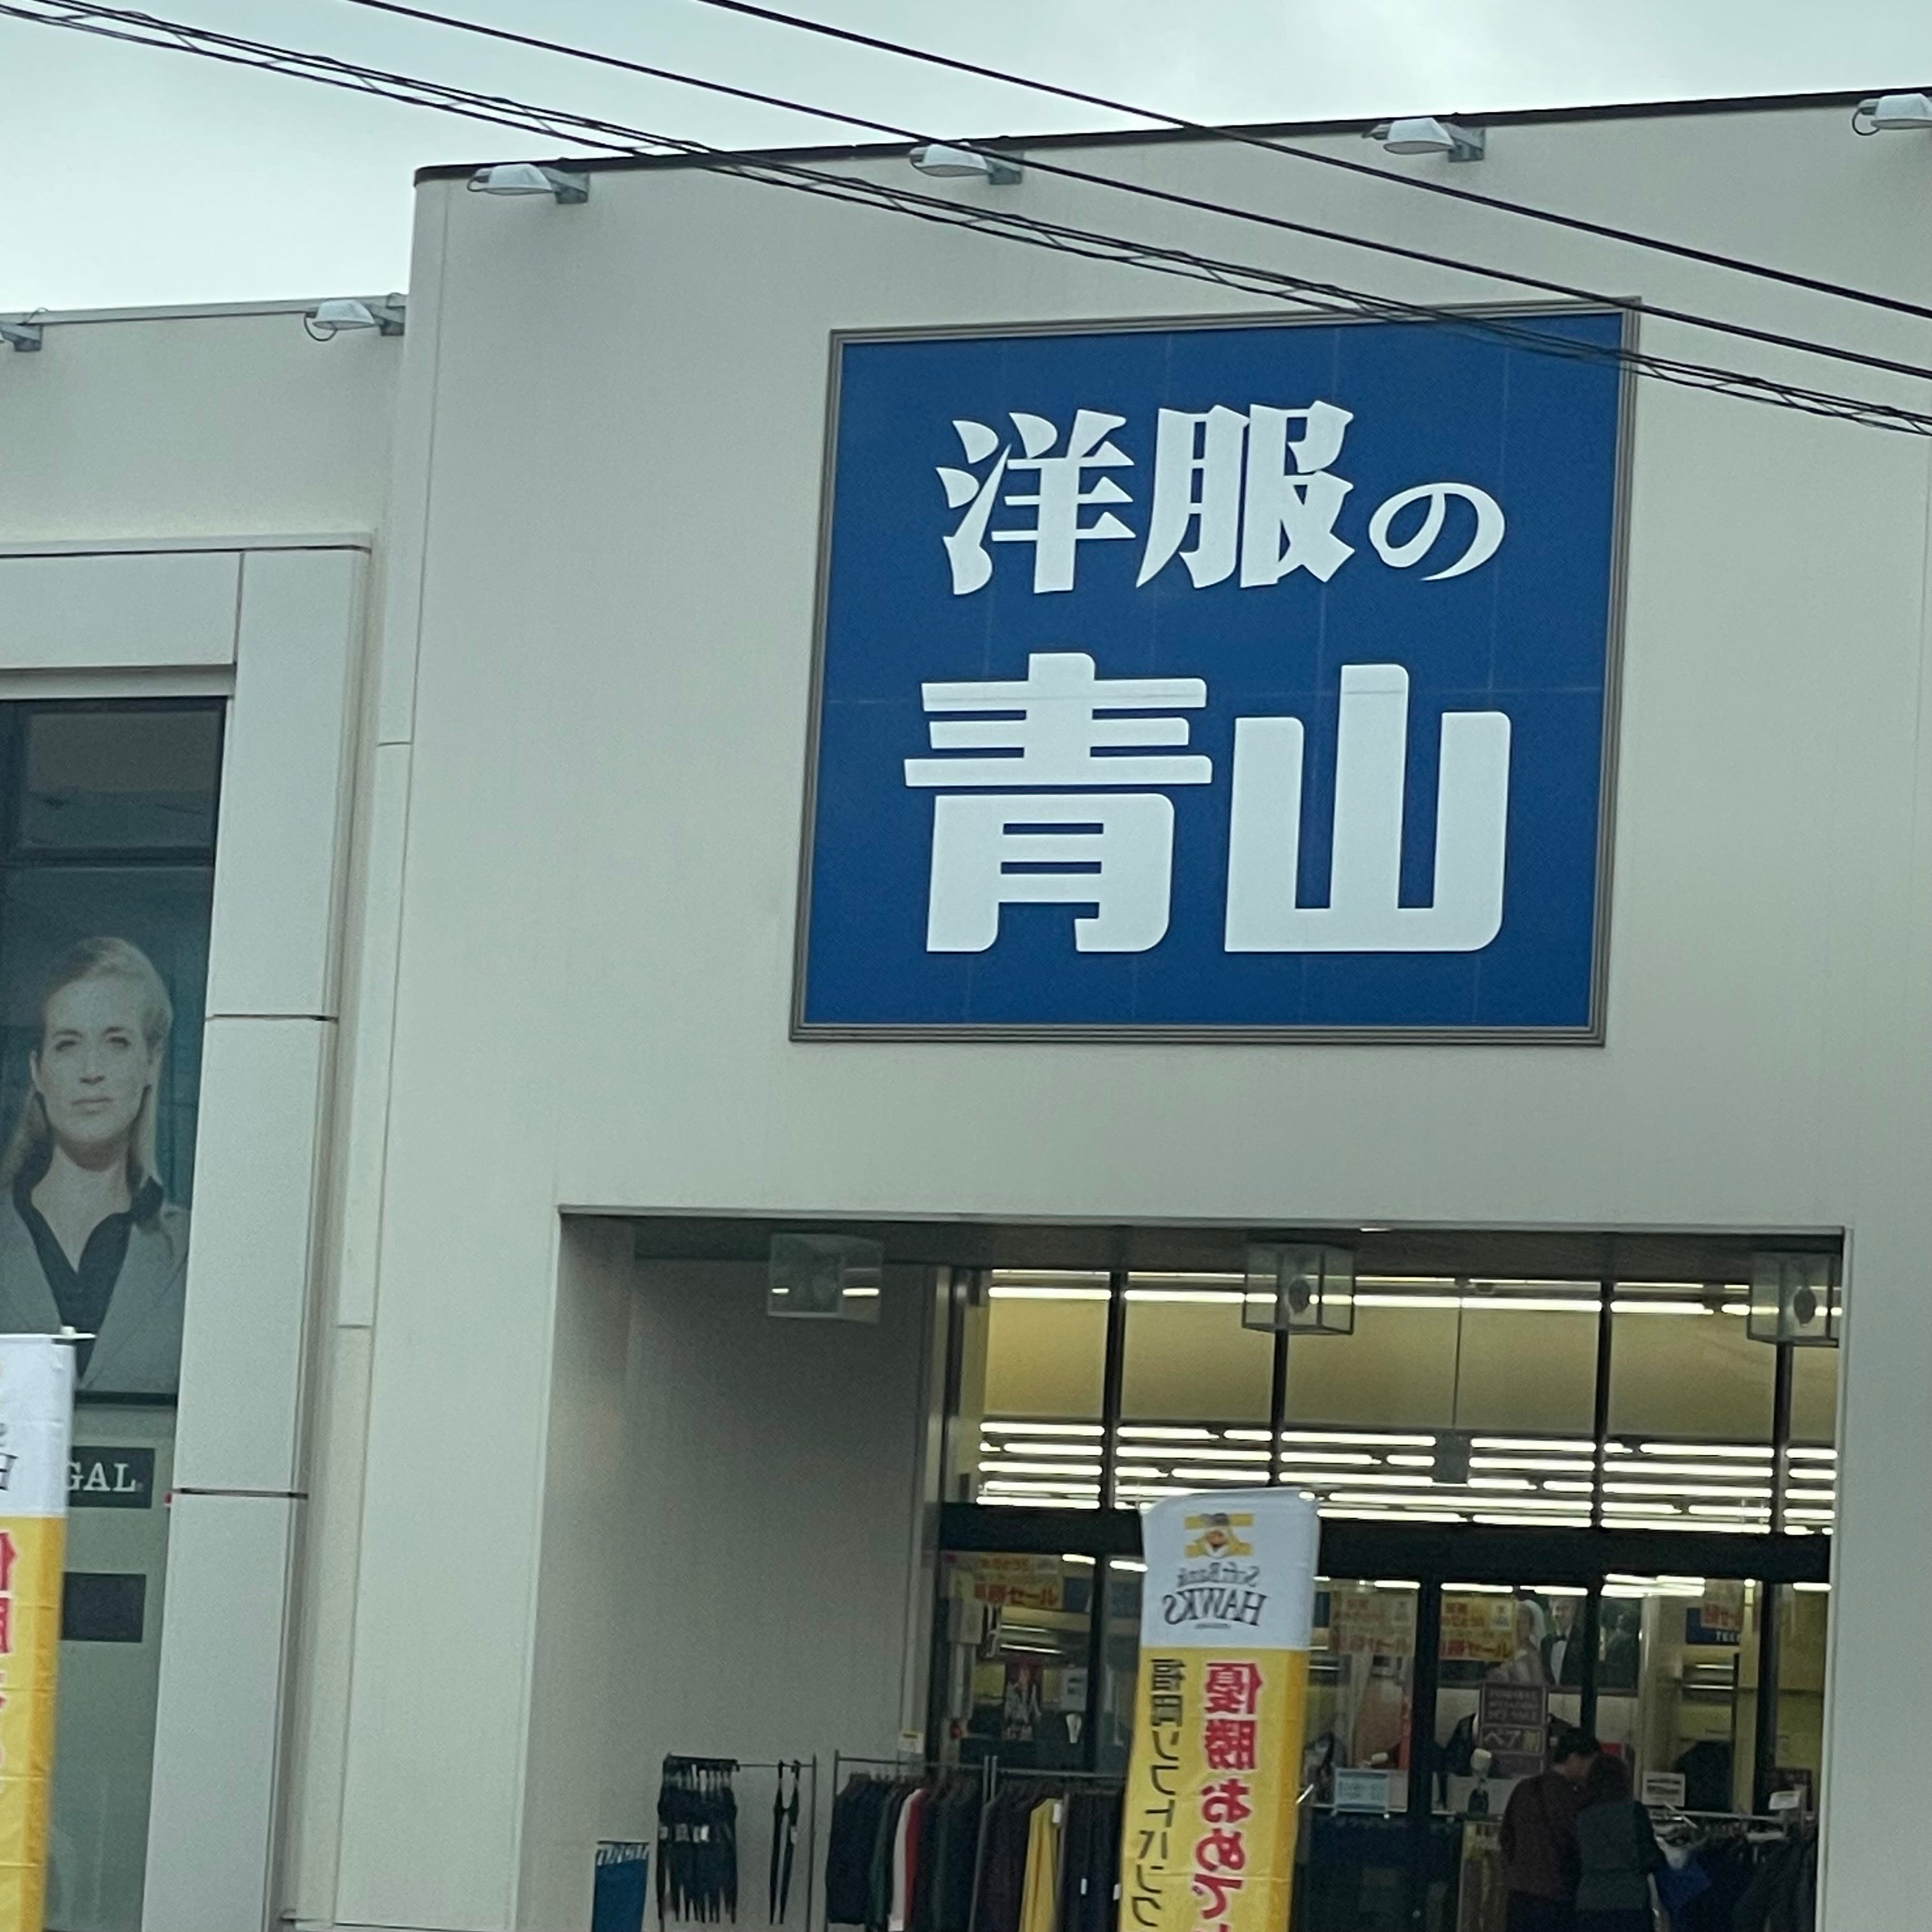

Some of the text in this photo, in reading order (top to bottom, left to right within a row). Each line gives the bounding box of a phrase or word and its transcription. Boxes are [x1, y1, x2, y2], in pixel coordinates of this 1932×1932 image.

[936, 399, 1505, 595] 洋服の
[904, 652, 1511, 953] 青山
